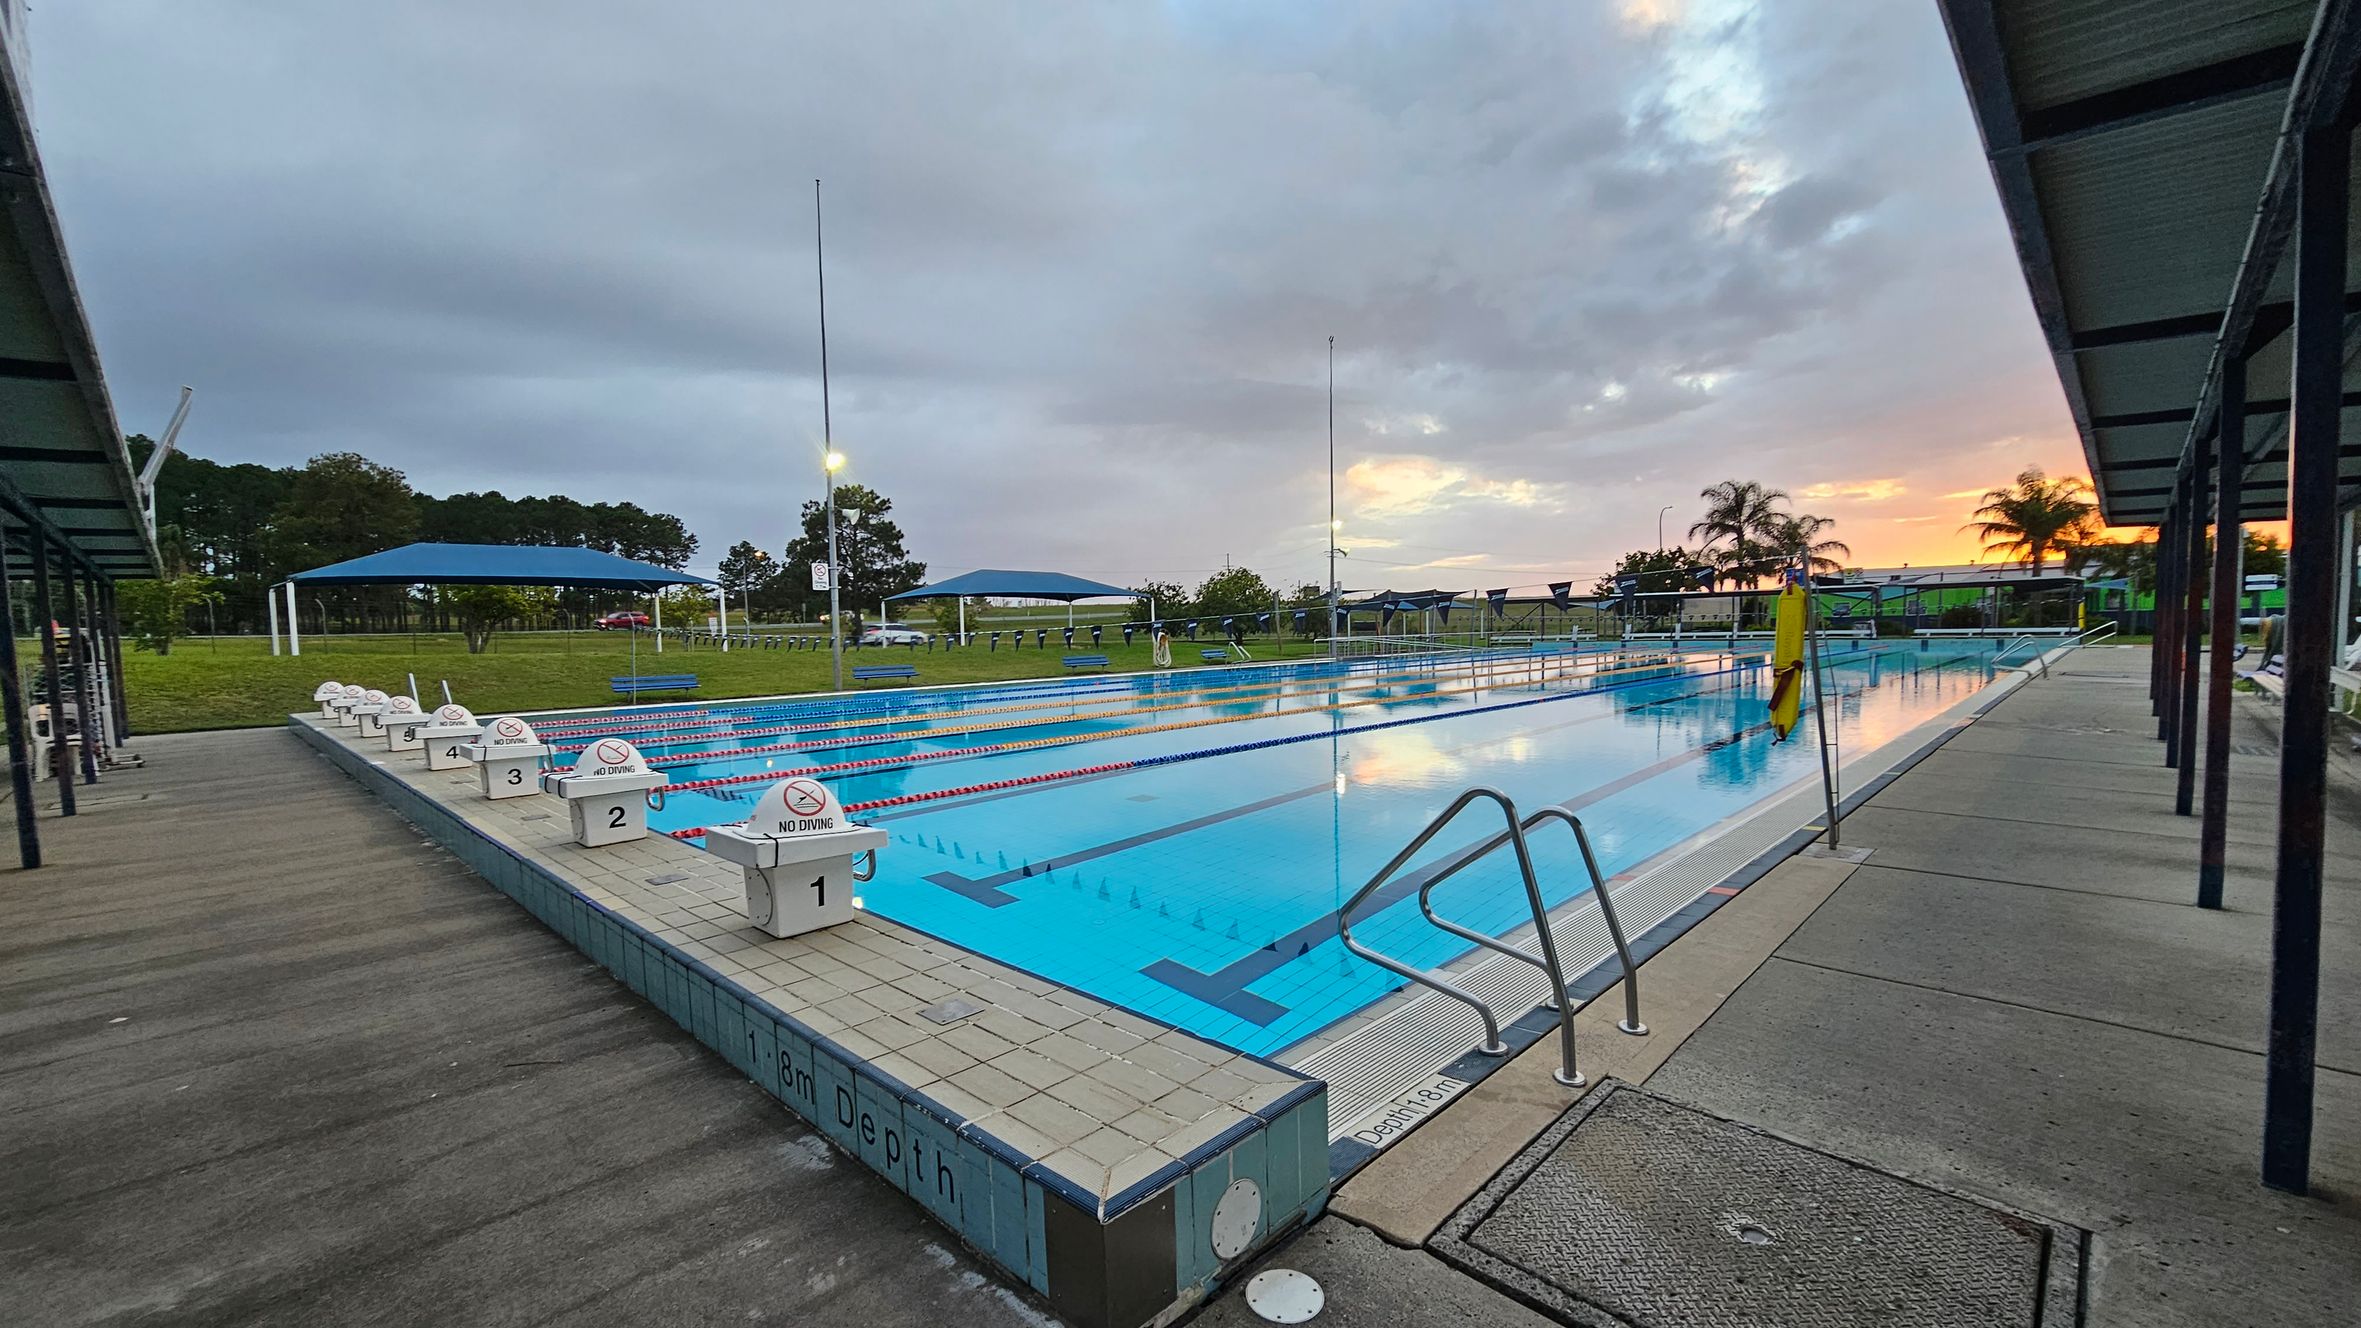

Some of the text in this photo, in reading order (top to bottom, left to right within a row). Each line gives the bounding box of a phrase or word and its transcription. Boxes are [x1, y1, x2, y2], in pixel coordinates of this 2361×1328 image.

[506, 737, 528, 745] DIVING
[446, 746, 459, 759] 4
[507, 768, 523, 785] 3
[593, 765, 636, 776] NO DIVING
[608, 806, 627, 829] 2
[779, 817, 834, 833] NO DIVING
[810, 875, 825, 907] 1
[1354, 1108, 1420, 1144] Depth
[836, 1085, 955, 1204] Depth
